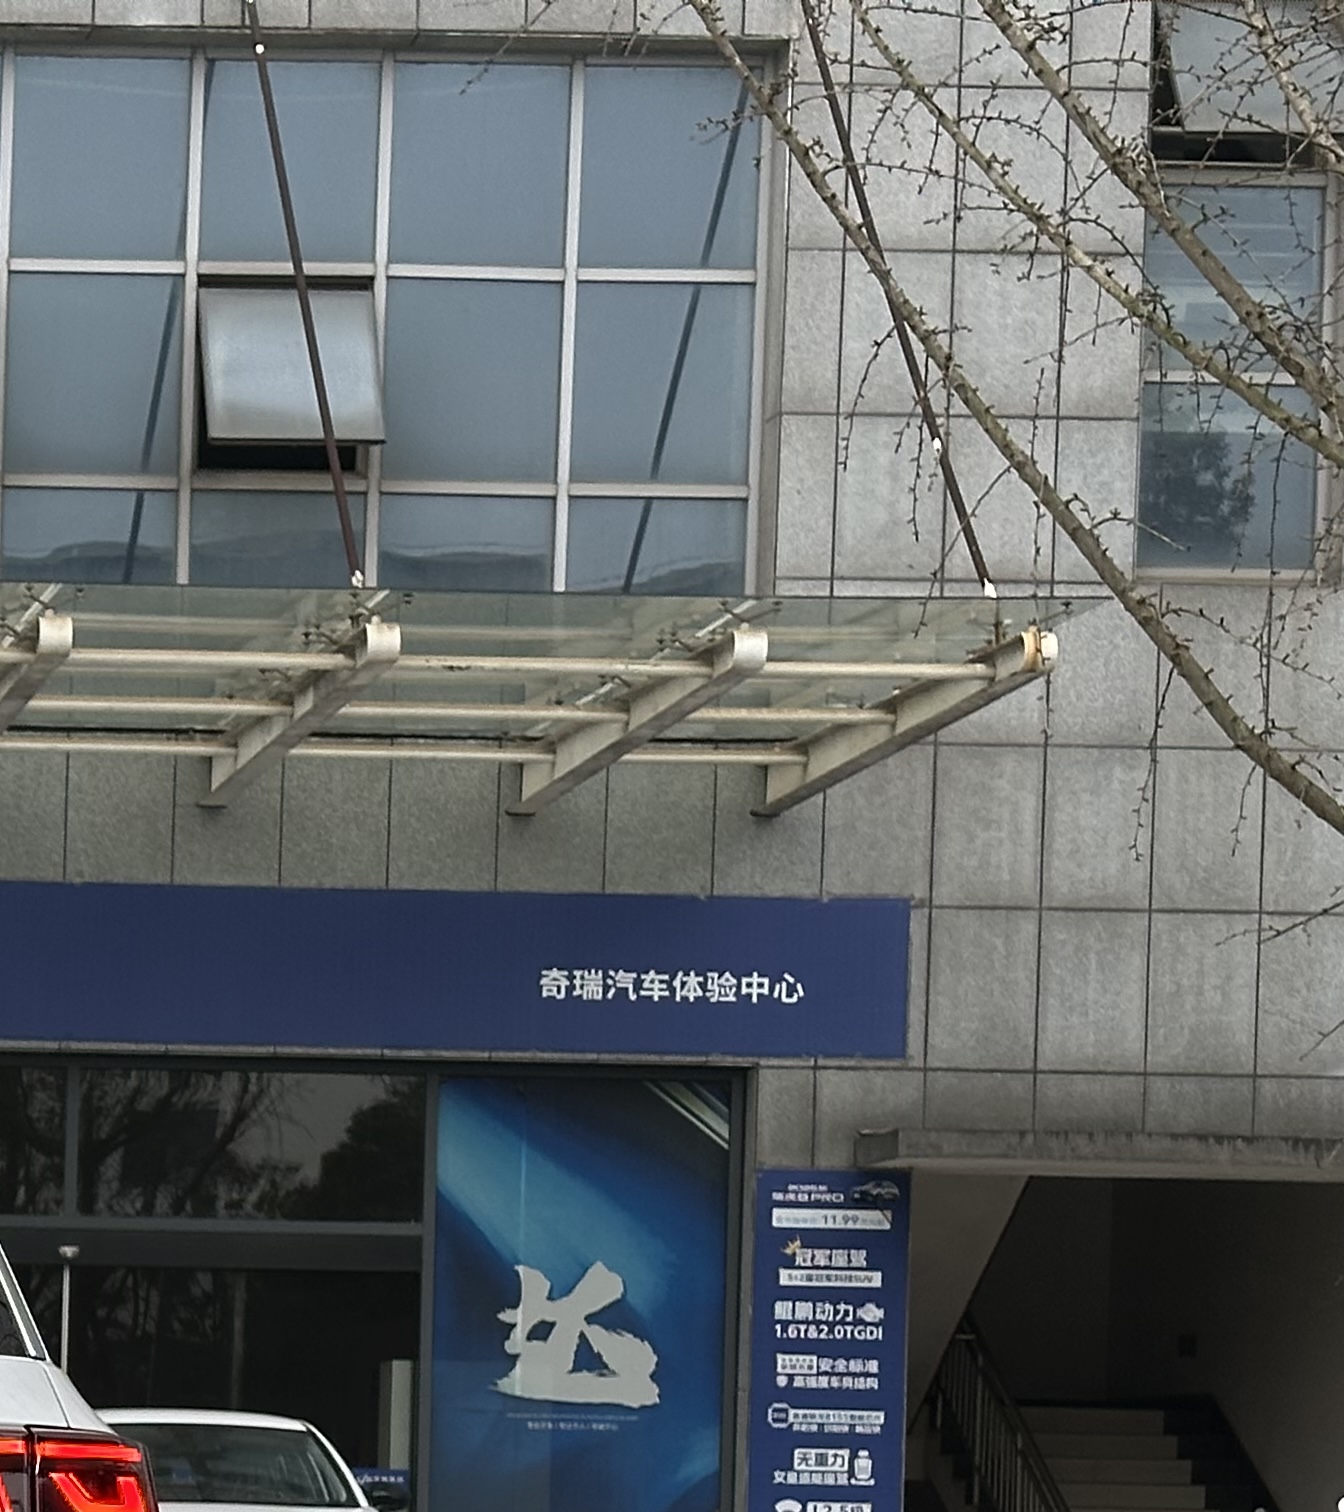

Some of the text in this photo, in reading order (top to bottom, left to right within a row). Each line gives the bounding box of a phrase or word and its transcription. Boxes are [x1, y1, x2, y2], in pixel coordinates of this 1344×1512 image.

[538, 967, 805, 1004] 奇瑞汽车体验中心
[820, 1213, 860, 1226] 11.99
[774, 1300, 854, 1322] 鲲鹏动力
[774, 1324, 884, 1341] 1.6T&2.0TGDI
[817, 1356, 880, 1374] 安全标准
[796, 1451, 846, 1468] 无重力
